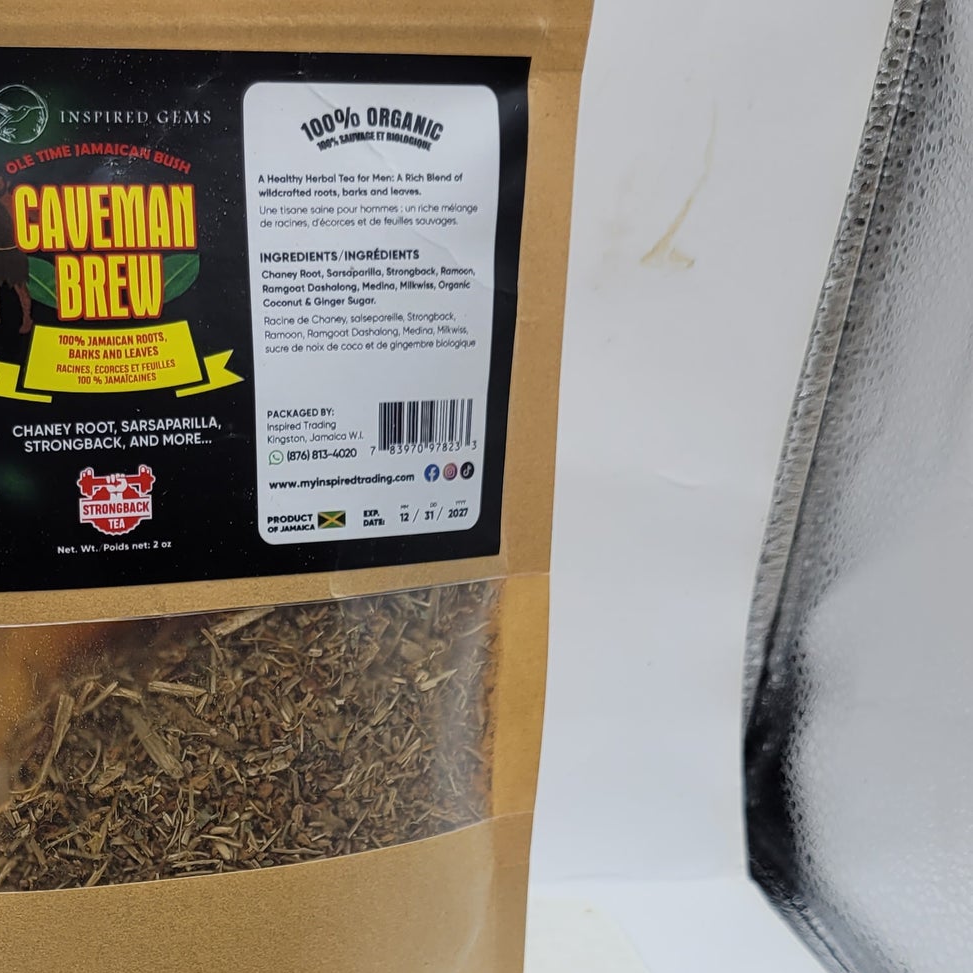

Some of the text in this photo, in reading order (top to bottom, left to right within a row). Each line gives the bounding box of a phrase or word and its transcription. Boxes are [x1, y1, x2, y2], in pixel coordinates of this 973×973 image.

[59, 110, 212, 124] INSPIRED GEMS
[300, 107, 444, 143] 100% ORGANIC
[5, 143, 192, 175] OLE TIME JAMAICAN BUSH
[12, 183, 197, 252] CAVEMAN
[260, 248, 420, 263] INGREDIENTS/INGRÉDIENTS
[261, 267, 476, 281] Chaney Root, Sarsaparilla, Strongback, Ramoon,
[56, 253, 164, 320] BREW
[262, 279, 471, 296] Ramgoat Dashalong, Medina, Milkwiss, Organic
[263, 295, 376, 308] Coconut & Ginger Sugar.
[58, 332, 167, 347] 100% JAMAICAN ROOTS,
[68, 346, 159, 359] BARKS AND LEAVES
[267, 408, 334, 419] PACKAGED BY:
[12, 416, 222, 437] CHANEY ROOT, SARSAPARILLA,
[267, 420, 337, 432] Inspired Trading
[24, 432, 212, 453] STRONGBACK, AND MORE...
[267, 431, 364, 445] Kingston, Jamaica W.I.
[287, 448, 357, 462] (876) 813-4020
[370, 440, 477, 456] 7 83970 97823 3
[269, 474, 415, 489] www.myinspiredtrading.com
[82, 501, 150, 515] STRONGBACK
[363, 510, 380, 518] EXP.
[400, 513, 409, 522] 12
[424, 511, 434, 520] 31
[448, 508, 468, 519] 2027
[108, 518, 125, 529] TEA
[267, 514, 313, 524] PRODUCT
[363, 518, 385, 527] DATE:
[267, 523, 315, 534] OF JAMAICA
